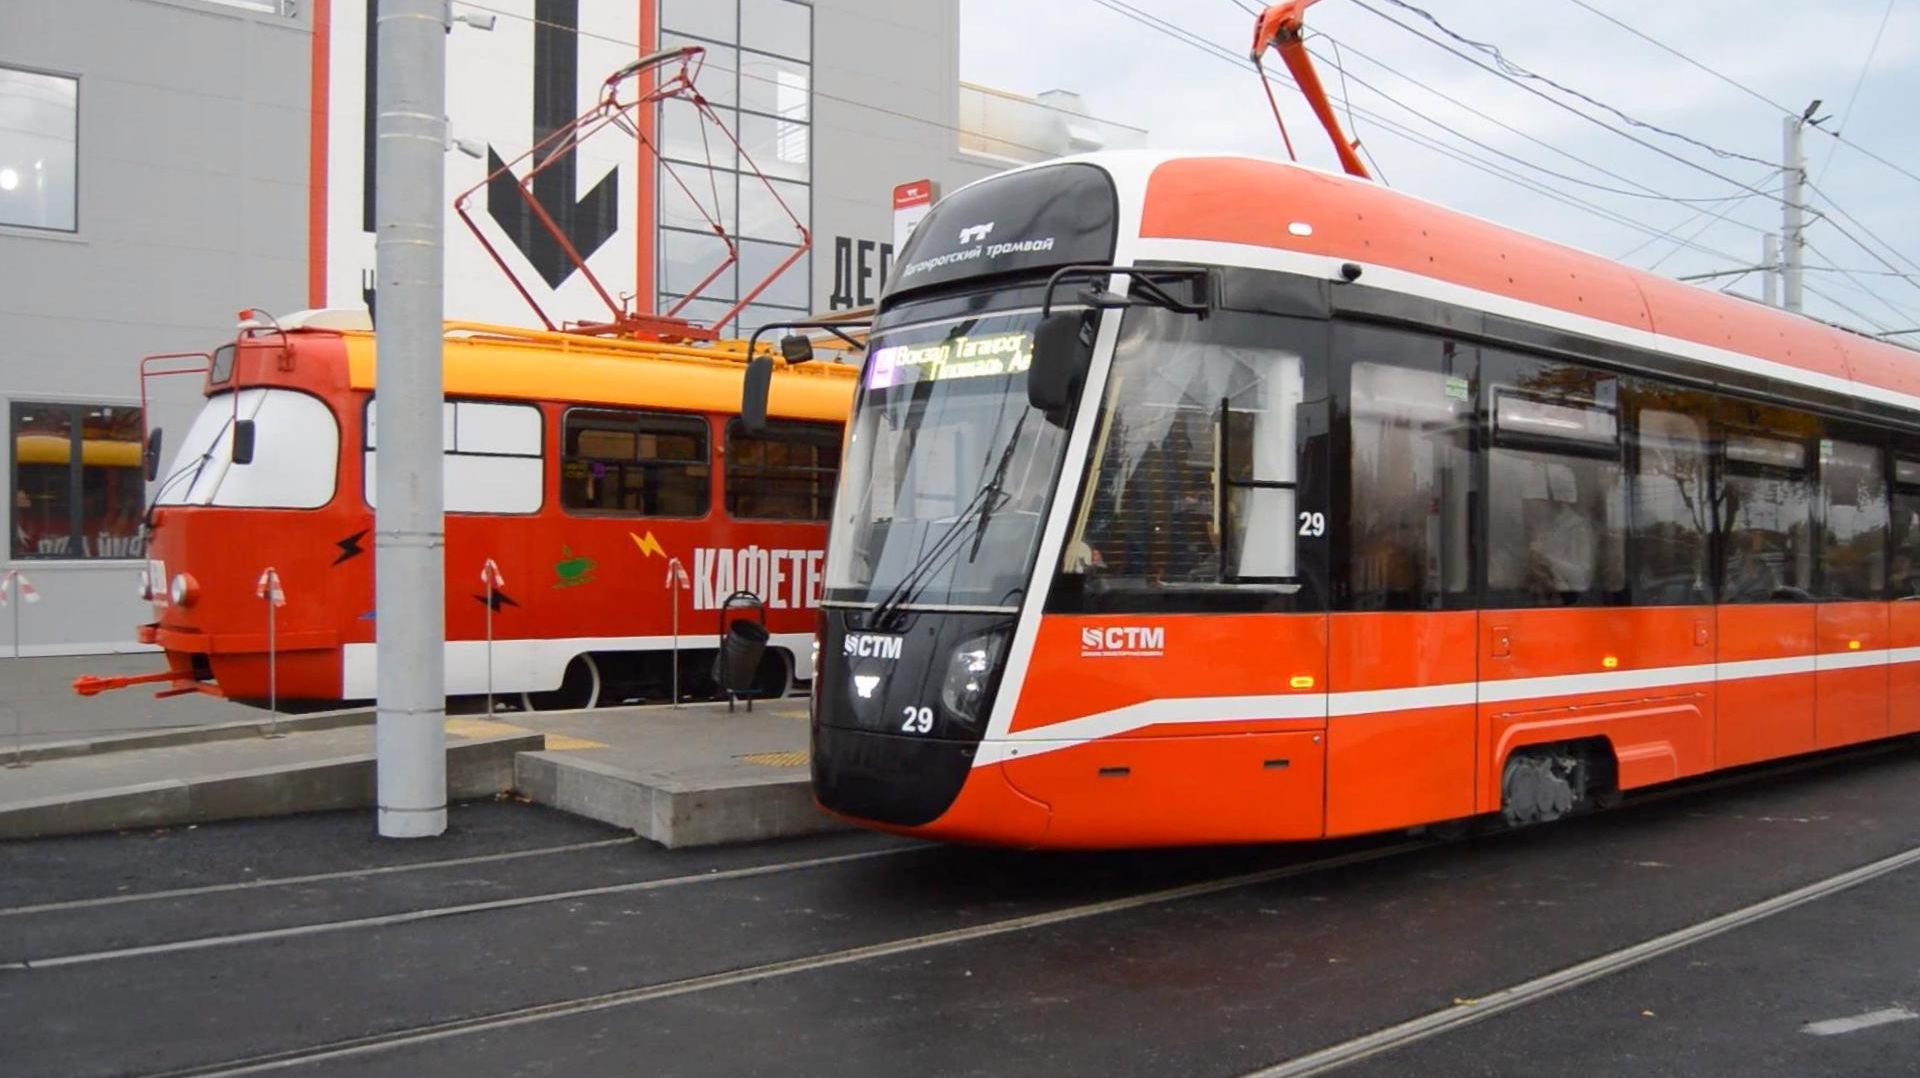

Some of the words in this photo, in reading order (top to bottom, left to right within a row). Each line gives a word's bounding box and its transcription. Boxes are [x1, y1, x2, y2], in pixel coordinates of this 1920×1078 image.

[986, 237, 1055, 258] трамвай
[1299, 511, 1325, 537] 29
[858, 635, 903, 659] СТМ
[1105, 627, 1164, 649] СТМ
[901, 706, 933, 733] 29
